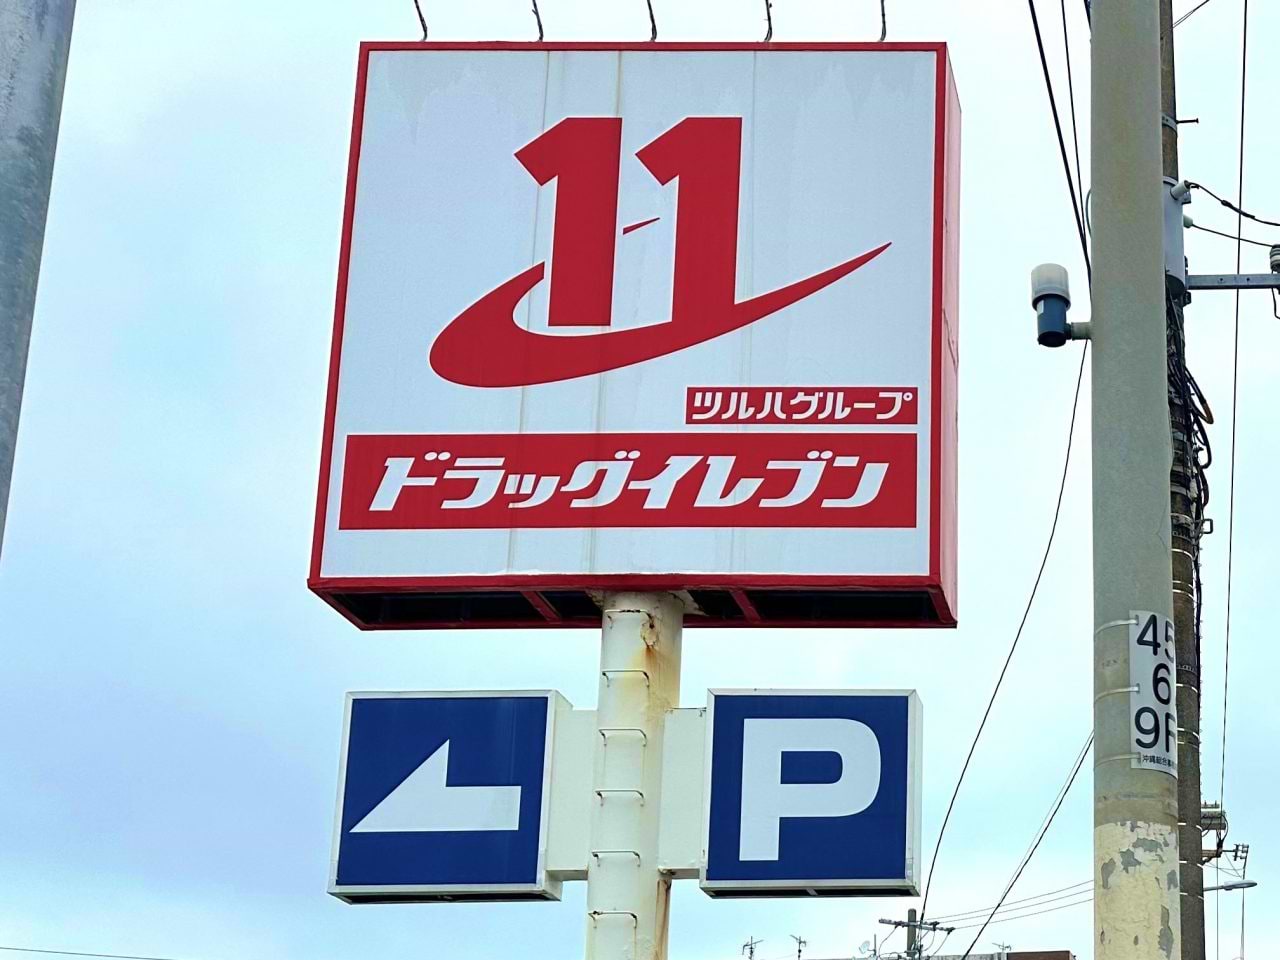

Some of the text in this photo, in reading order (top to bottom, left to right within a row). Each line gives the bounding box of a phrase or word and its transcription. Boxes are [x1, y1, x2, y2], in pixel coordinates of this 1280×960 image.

[692, 391, 913, 420] ツルハグループ
[369, 449, 890, 511] ドラッグイレブン
[738, 718, 882, 862] P
